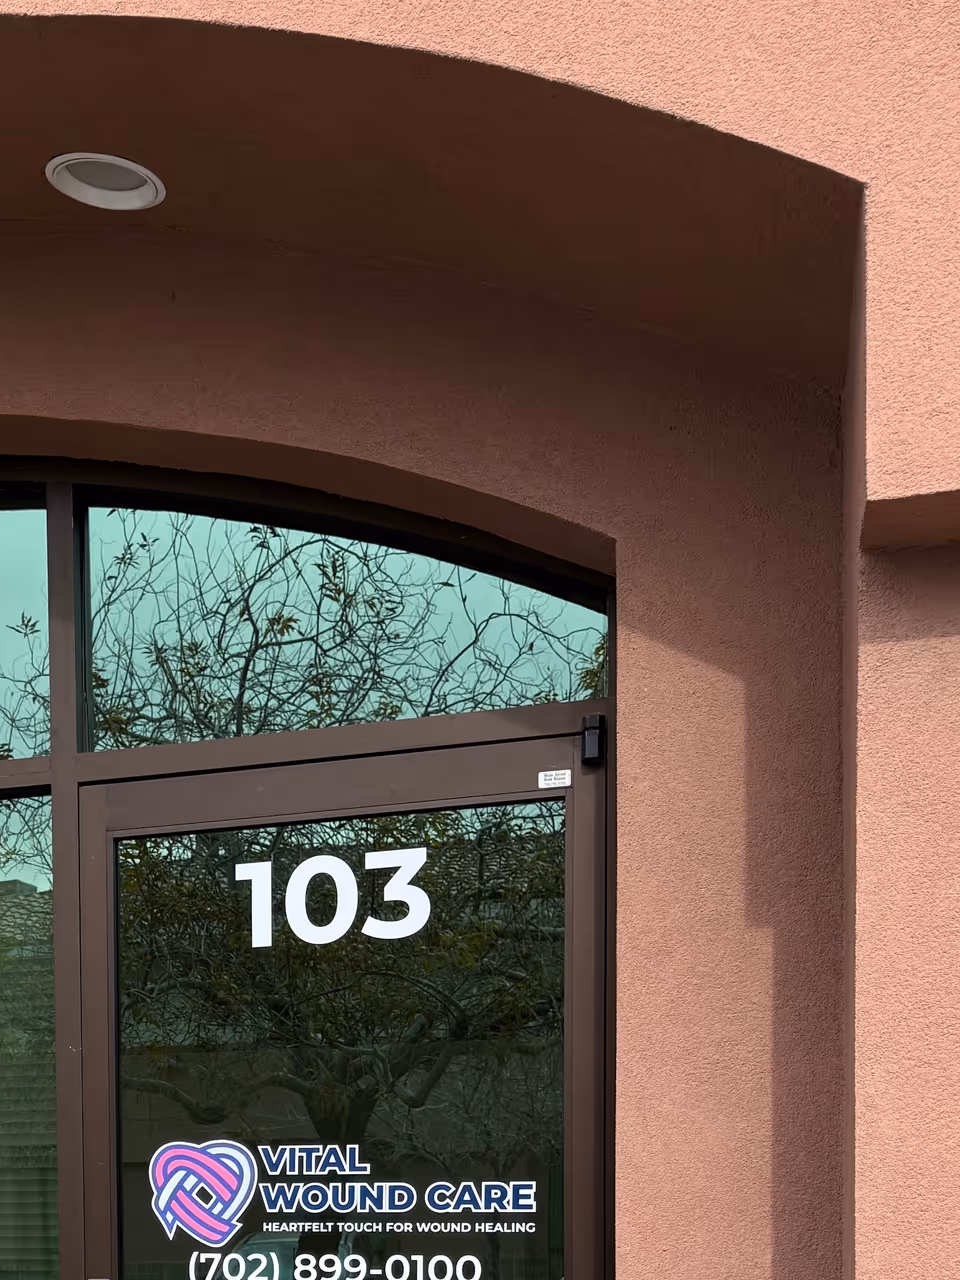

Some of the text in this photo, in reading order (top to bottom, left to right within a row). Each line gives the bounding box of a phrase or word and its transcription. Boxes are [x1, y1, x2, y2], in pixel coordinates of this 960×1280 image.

[235, 847, 431, 948] 103
[258, 1144, 371, 1175] VITAL
[259, 1181, 537, 1213] WOUND CARE
[262, 1222, 536, 1233] HEARTFELT TOUCH FOR WOUND HEALING
